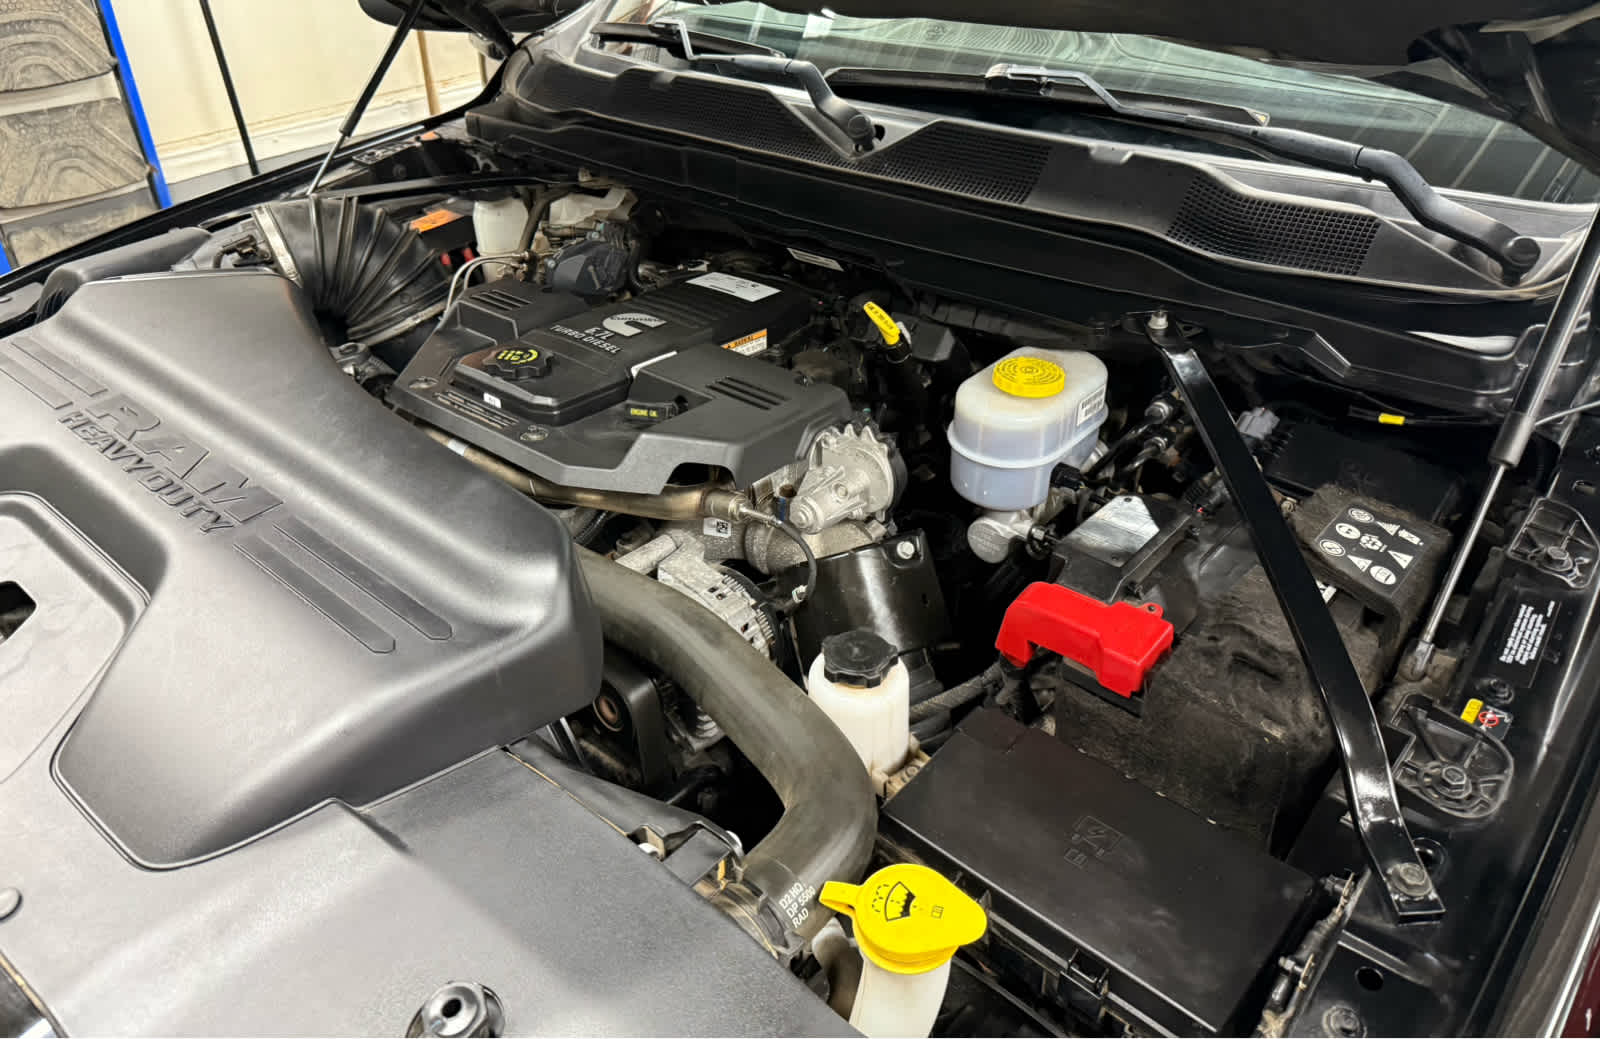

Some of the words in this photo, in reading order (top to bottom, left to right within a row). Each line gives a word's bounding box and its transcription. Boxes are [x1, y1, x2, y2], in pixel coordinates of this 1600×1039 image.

[549, 324, 586, 339] TURBO
[582, 336, 621, 354] DIESEL
[57, 411, 153, 472] HEAVY
[138, 471, 234, 532] DUTY
[85, 393, 283, 524] RAM
[786, 902, 799, 919] DP
[792, 907, 809, 928] RAD
